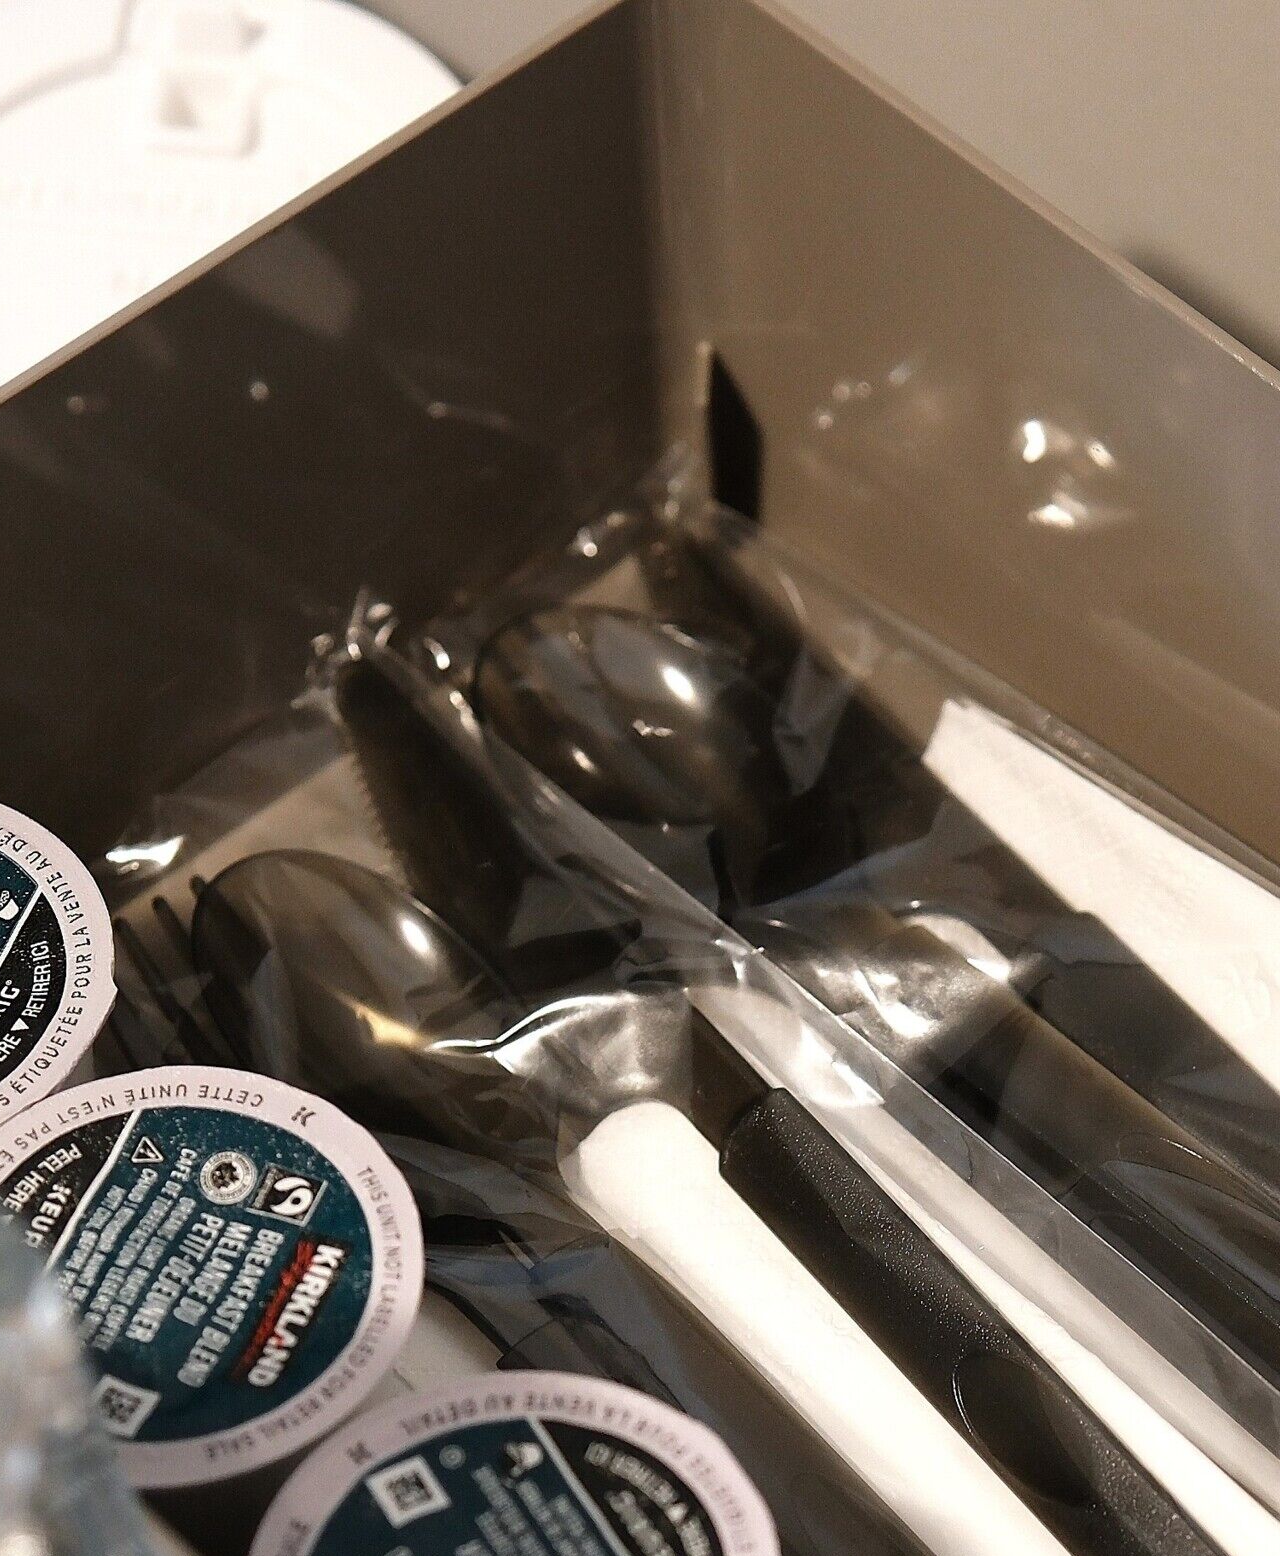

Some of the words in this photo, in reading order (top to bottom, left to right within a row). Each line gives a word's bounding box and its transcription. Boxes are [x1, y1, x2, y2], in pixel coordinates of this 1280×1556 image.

[25, 850, 53, 871] AU
[47, 872, 84, 924] VENTE
[30, 939, 50, 961] ICI
[71, 925, 92, 948] LA
[21, 961, 51, 1018] RETIRER
[71, 952, 93, 999] POUR
[10, 1005, 83, 1094] ÉTIQUETÉE
[56, 1094, 116, 1125] N'EST
[124, 1083, 187, 1106] UNITÉ
[197, 1084, 264, 1108] CETTE
[14, 1122, 52, 1150] PAS
[38, 1143, 83, 1173] PEEL
[2, 1170, 45, 1212] HERE
[356, 1166, 389, 1202] THIS
[24, 1183, 72, 1249] KEUR
[376, 1202, 401, 1240] UNIT
[125, 1212, 225, 1344] PETIT-DÉJEUNER
[186, 1221, 253, 1304] MÉLANGE
[211, 1228, 285, 1335] BREAKFAST
[382, 1246, 403, 1280] NOT
[247, 1243, 346, 1387] KIRKLAND
[177, 1325, 231, 1388] BLEND
